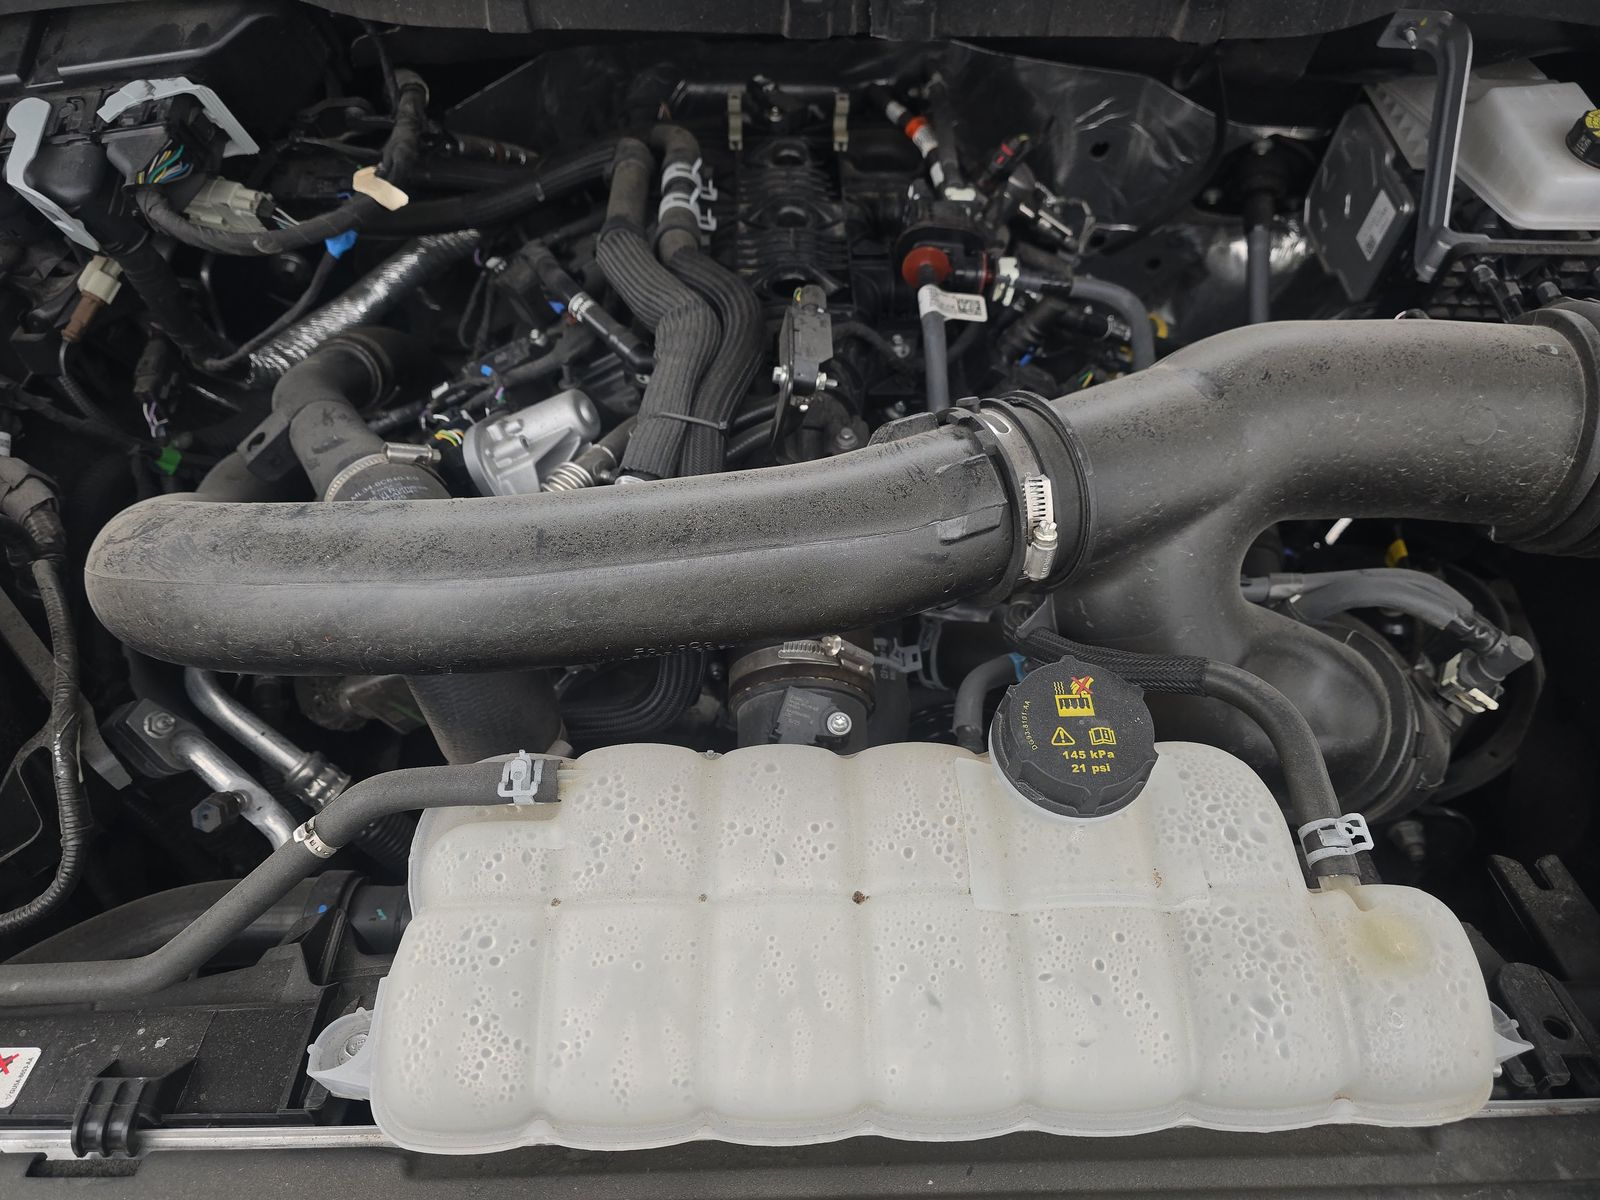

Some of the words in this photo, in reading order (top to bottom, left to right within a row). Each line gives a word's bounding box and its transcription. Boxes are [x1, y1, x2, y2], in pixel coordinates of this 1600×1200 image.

[1062, 750, 1087, 759] 145
[1089, 749, 1115, 759] kPa
[1071, 763, 1087, 773] 21
[1091, 763, 1111, 775] psi
